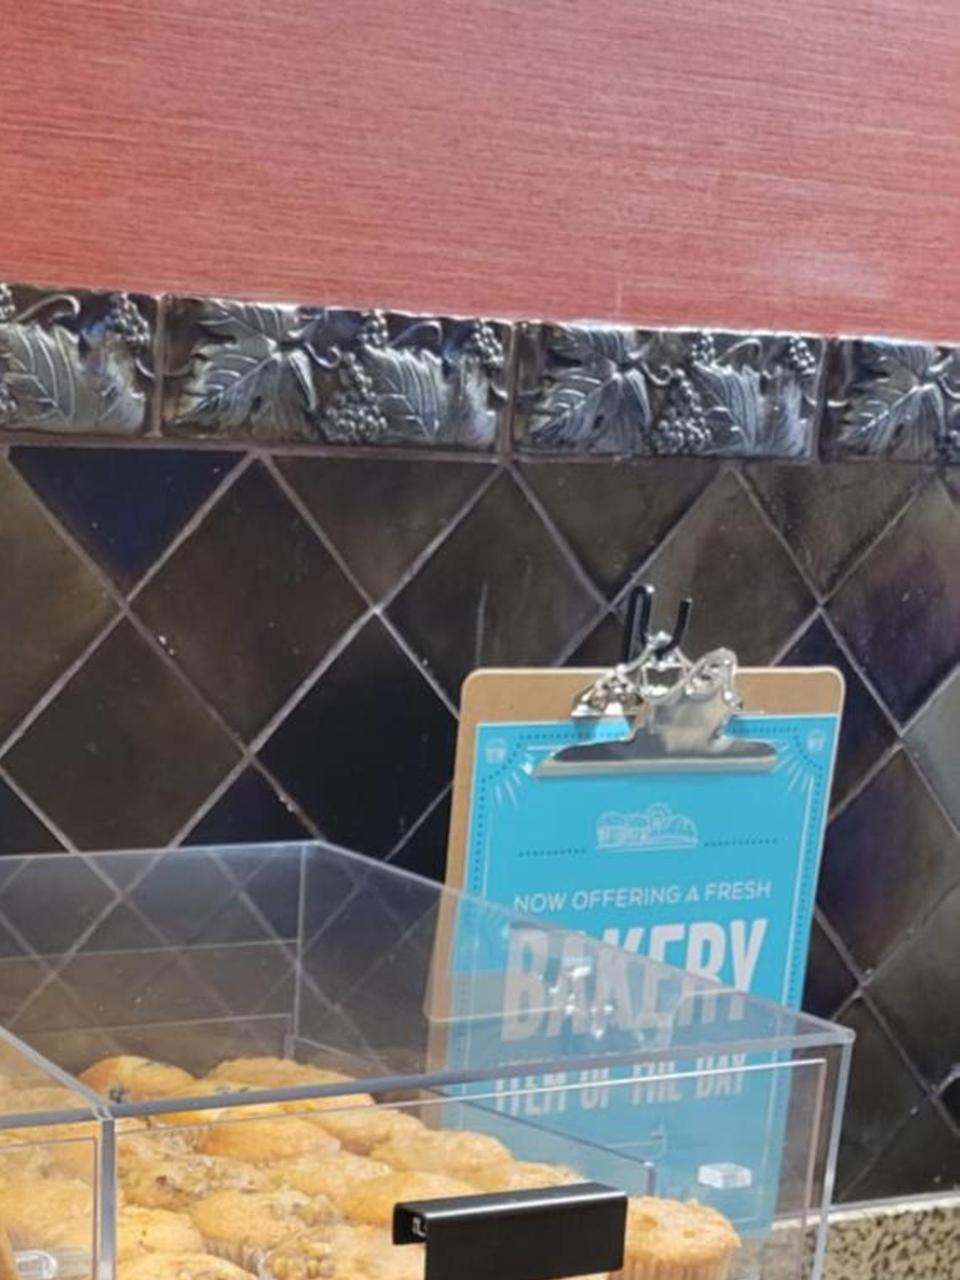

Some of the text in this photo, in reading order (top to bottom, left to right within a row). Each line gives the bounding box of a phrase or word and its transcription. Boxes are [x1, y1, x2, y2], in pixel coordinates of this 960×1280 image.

[514, 880, 772, 912] NOW OFFERING A FRESH
[501, 918, 768, 1041] BAKERY
